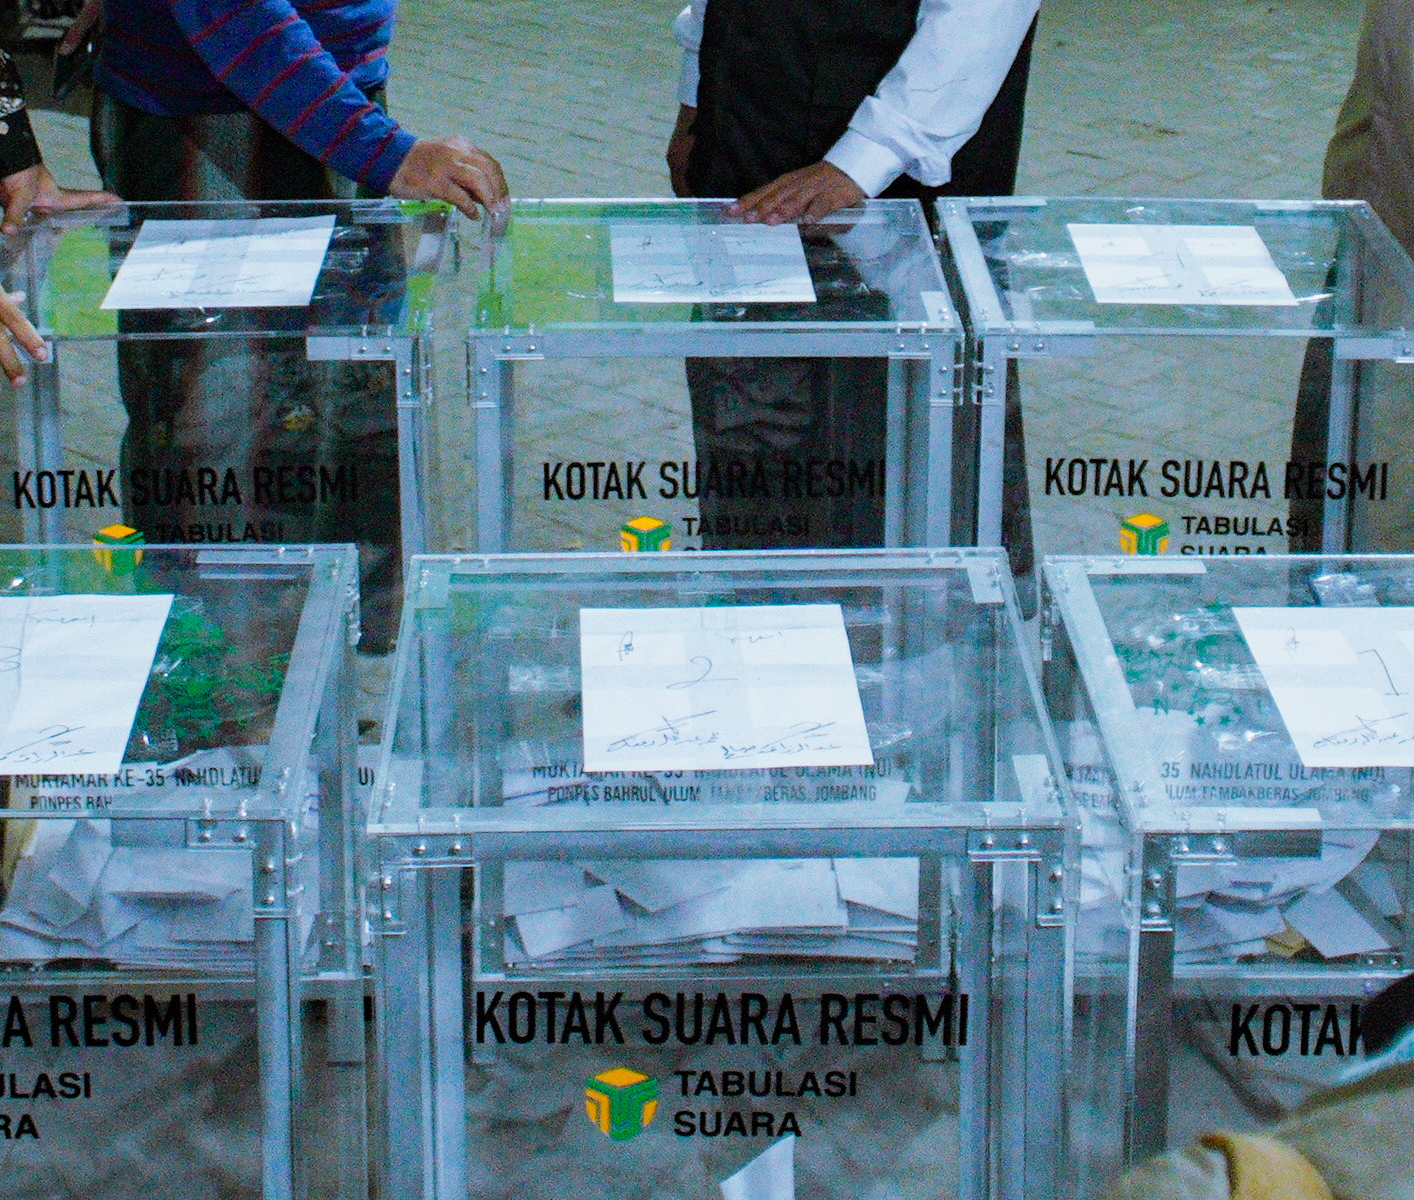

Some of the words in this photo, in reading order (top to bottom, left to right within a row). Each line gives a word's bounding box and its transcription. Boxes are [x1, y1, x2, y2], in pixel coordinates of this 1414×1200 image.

[13, 470, 118, 509] KOTAK
[130, 467, 243, 507] SUARA
[253, 464, 359, 504] RESMI
[543, 461, 647, 500] KOTAK
[659, 460, 770, 499] SUARA
[783, 459, 885, 498] RESMI
[1045, 457, 1149, 497] KOTAK
[1160, 460, 1271, 499] SUARA
[1284, 462, 1389, 500] RESMI
[157, 523, 283, 543] TABULASI
[682, 517, 810, 537] TABULASI
[1182, 516, 1309, 536] TABULASI
[114, 768, 165, 788] KE-35
[175, 765, 263, 788] NAHDLATU
[1189, 762, 1283, 780] NAHDLATUL
[603, 784, 657, 802] BAHRUL
[49, 993, 198, 1047] RESMI
[475, 990, 626, 1045] KOTAK
[641, 990, 801, 1046] SUARA
[819, 992, 969, 1047] RESMI
[674, 1070, 857, 1098] TABULASI
[673, 1111, 802, 1138] SUARA
